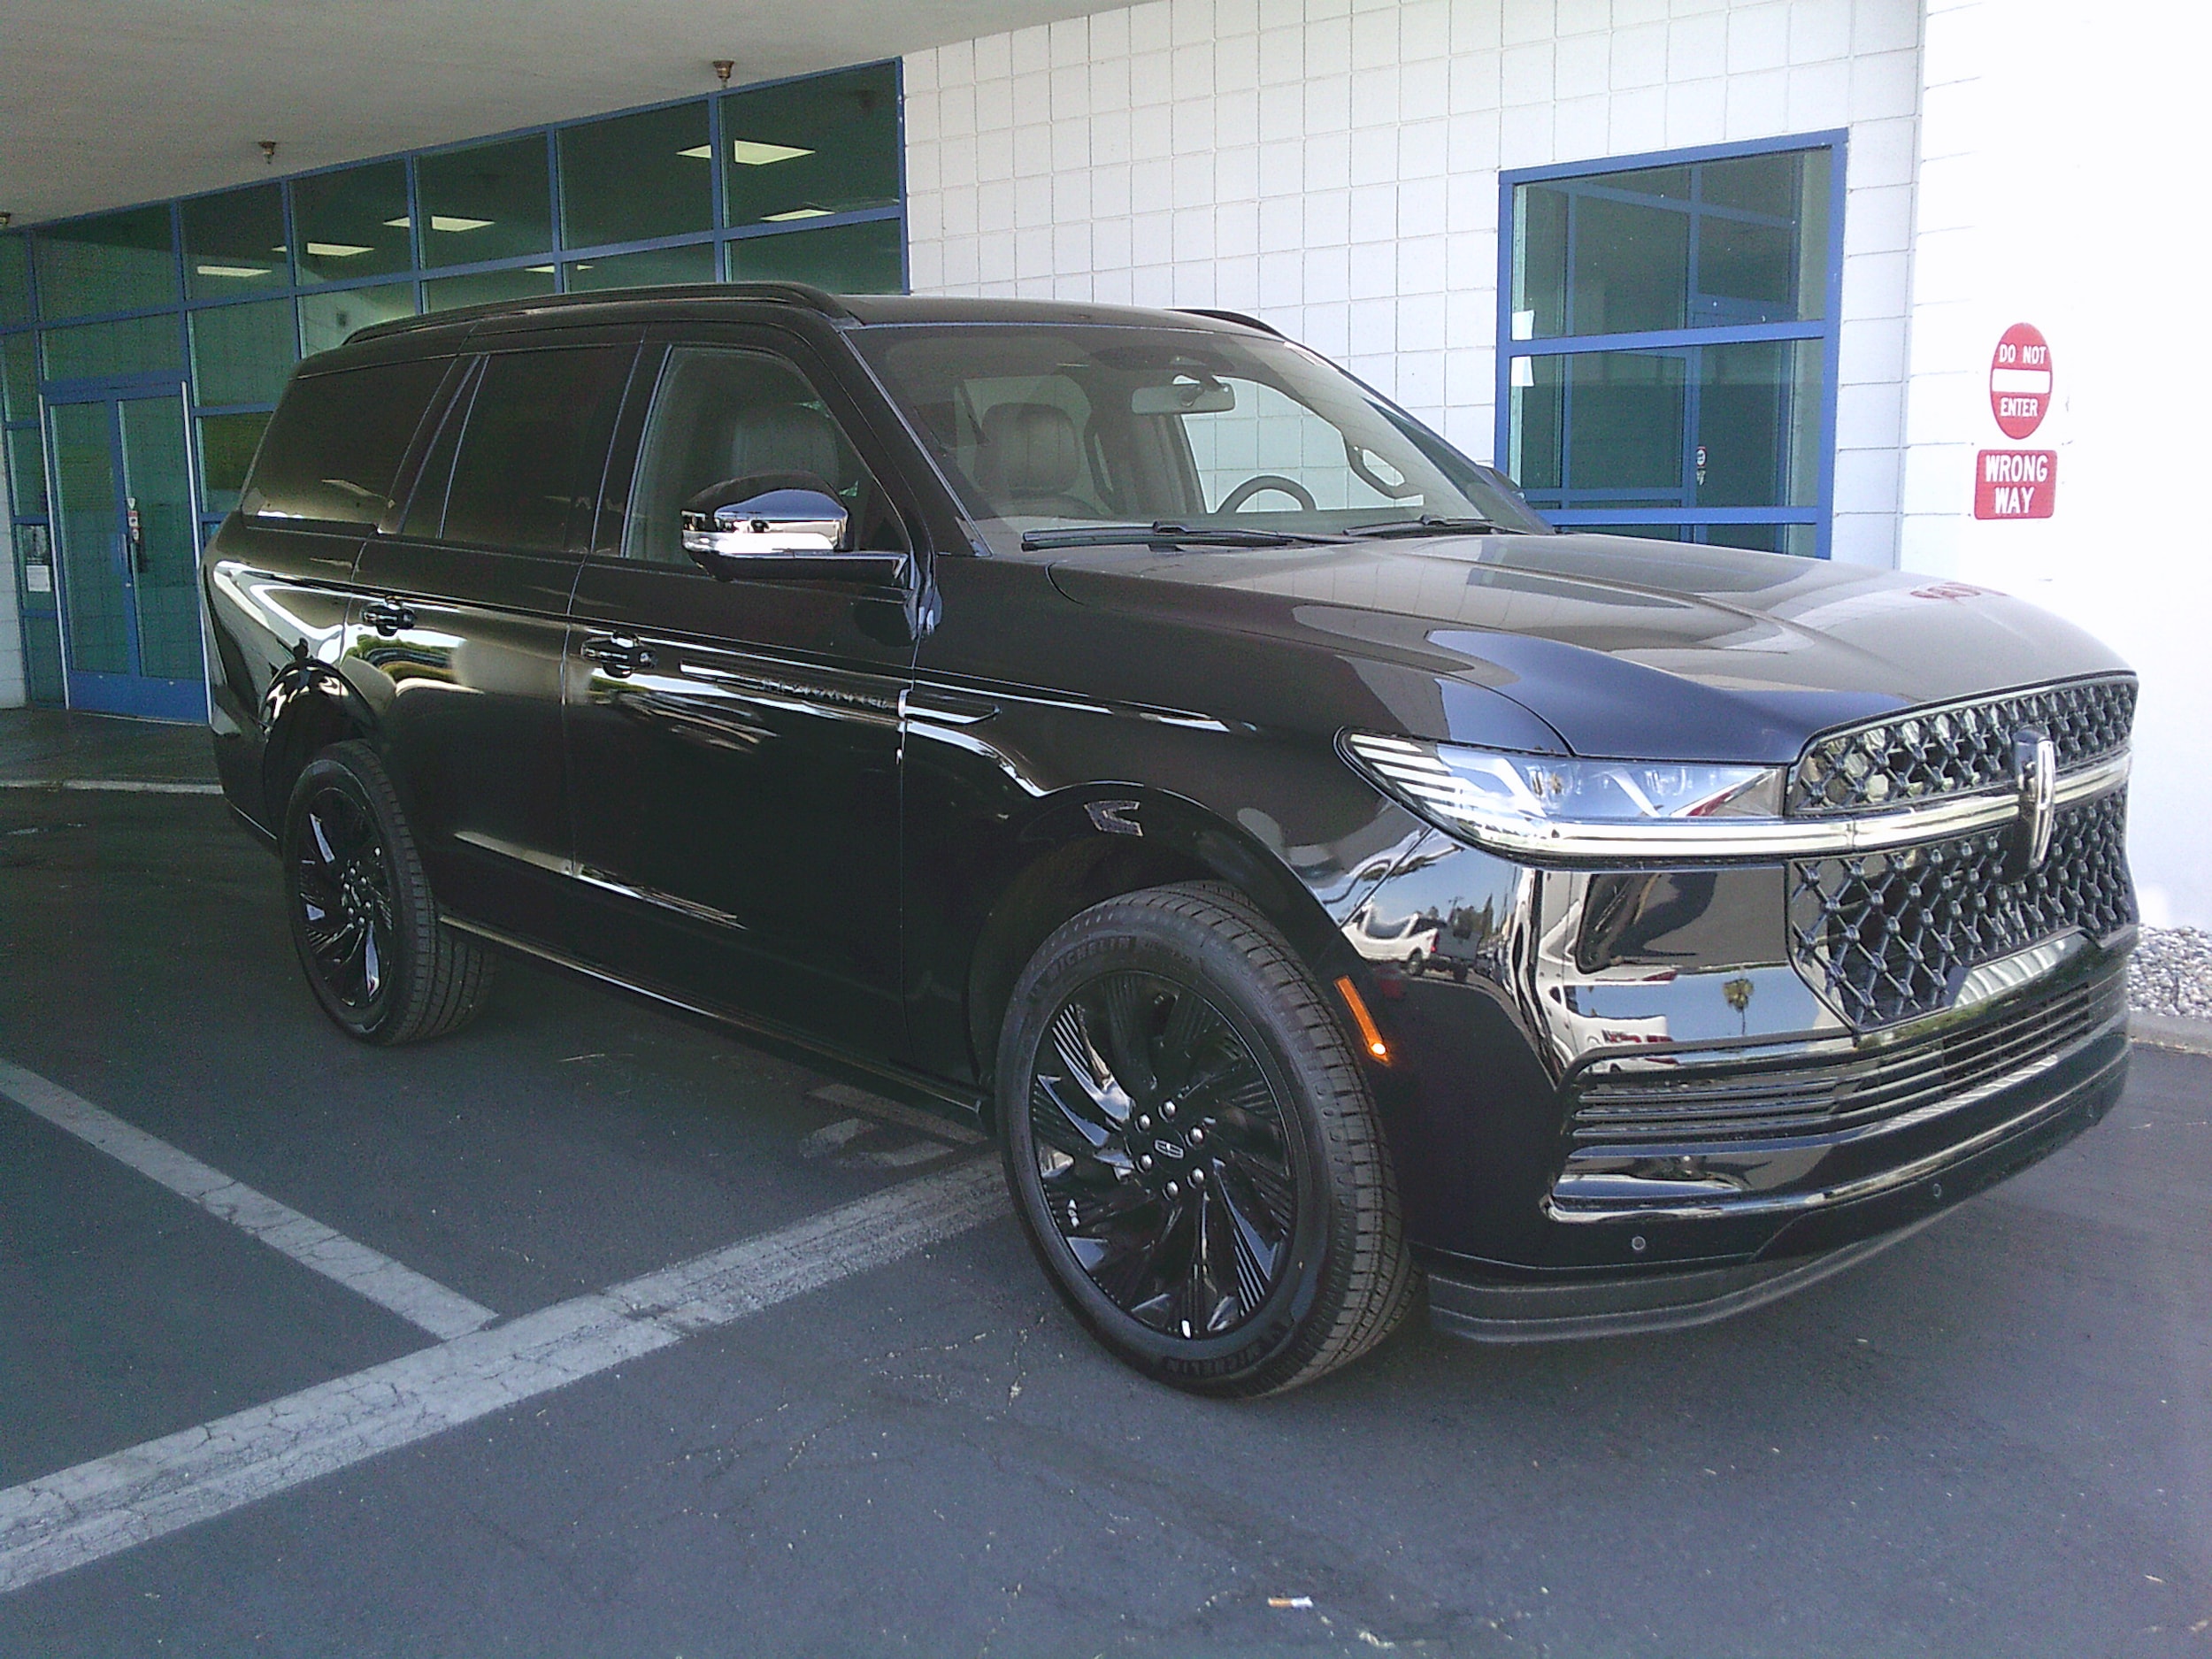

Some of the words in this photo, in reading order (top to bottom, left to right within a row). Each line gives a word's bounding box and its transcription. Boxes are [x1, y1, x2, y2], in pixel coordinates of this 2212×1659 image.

[1999, 343, 2016, 364] DO
[2023, 345, 2047, 365] NOT
[2000, 396, 2039, 418] ENTER
[1985, 454, 2049, 483] WRONG
[1994, 486, 2035, 514] WAY
